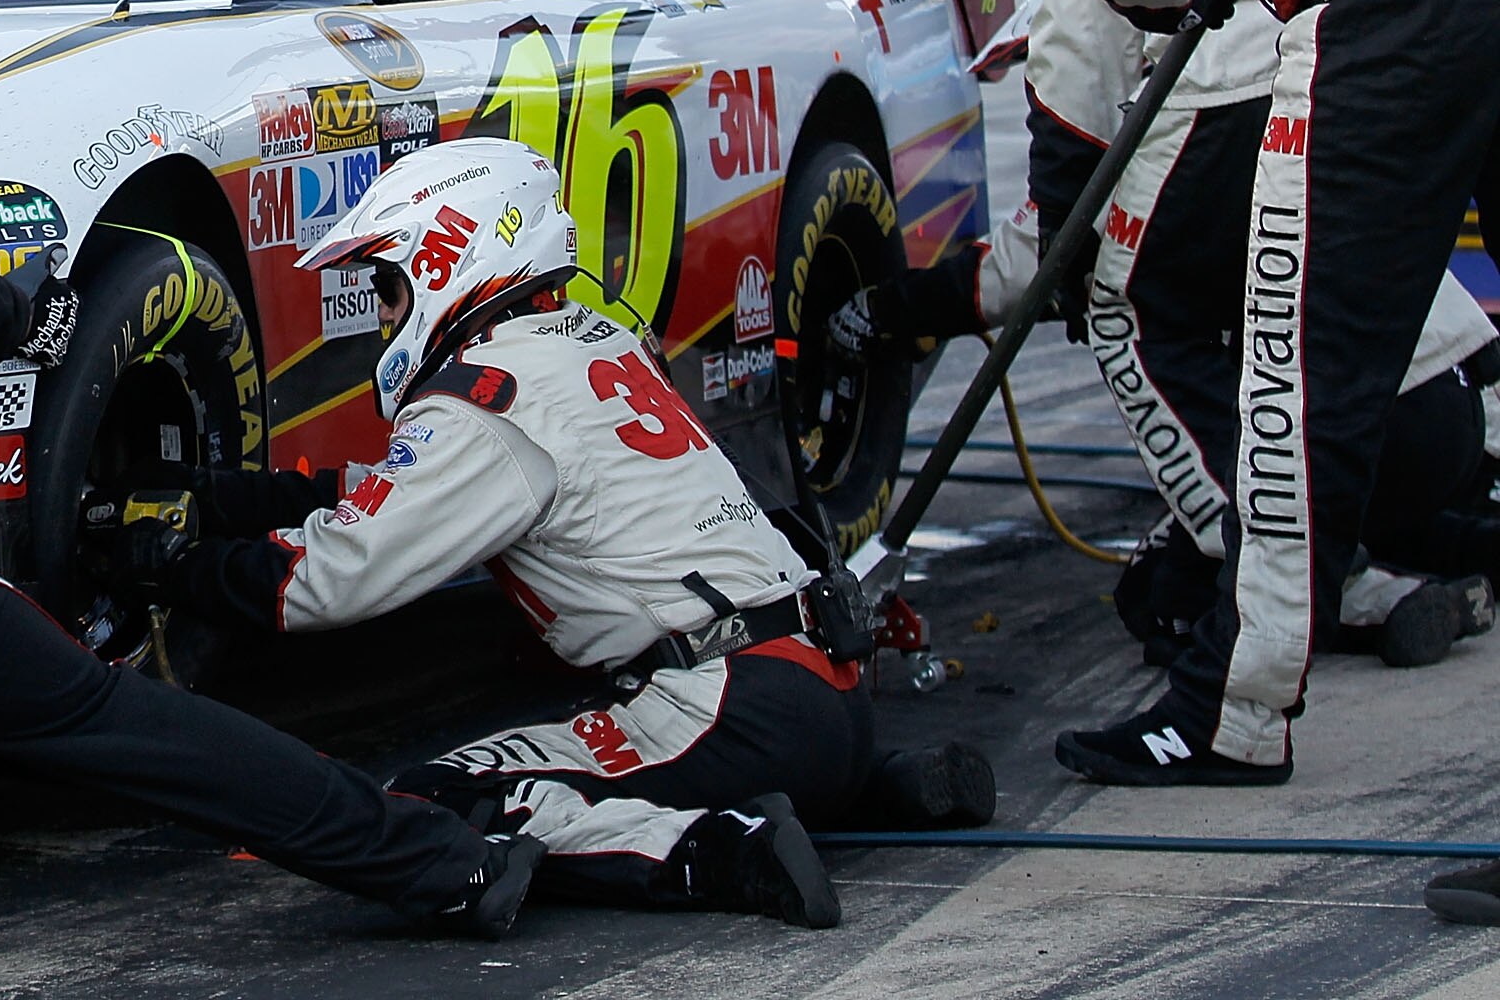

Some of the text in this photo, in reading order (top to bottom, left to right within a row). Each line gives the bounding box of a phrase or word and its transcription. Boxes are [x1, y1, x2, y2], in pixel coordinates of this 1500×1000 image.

[256, 94, 312, 151] Holley
[316, 125, 379, 152] MECHANIX WEAR
[407, 114, 435, 135] LIGHT
[708, 65, 780, 181] 3M
[1264, 116, 1308, 156] 3M
[73, 103, 225, 190] GOODYEAR
[261, 139, 303, 158] HP CARBS
[250, 166, 295, 248] 3M
[411, 164, 492, 206] 3M Innovation
[494, 200, 523, 248] 16
[1105, 203, 1146, 250] 3M
[410, 203, 479, 293] 3M
[786, 167, 897, 335] GOODYEAR
[322, 288, 378, 322] TISSOT
[738, 311, 770, 333] TOOLS
[385, 357, 406, 388] Ford
[393, 363, 419, 404] RACING
[727, 345, 775, 381] Dupli-Color
[1247, 204, 1306, 542] Innovation
[572, 710, 644, 775] 3M
